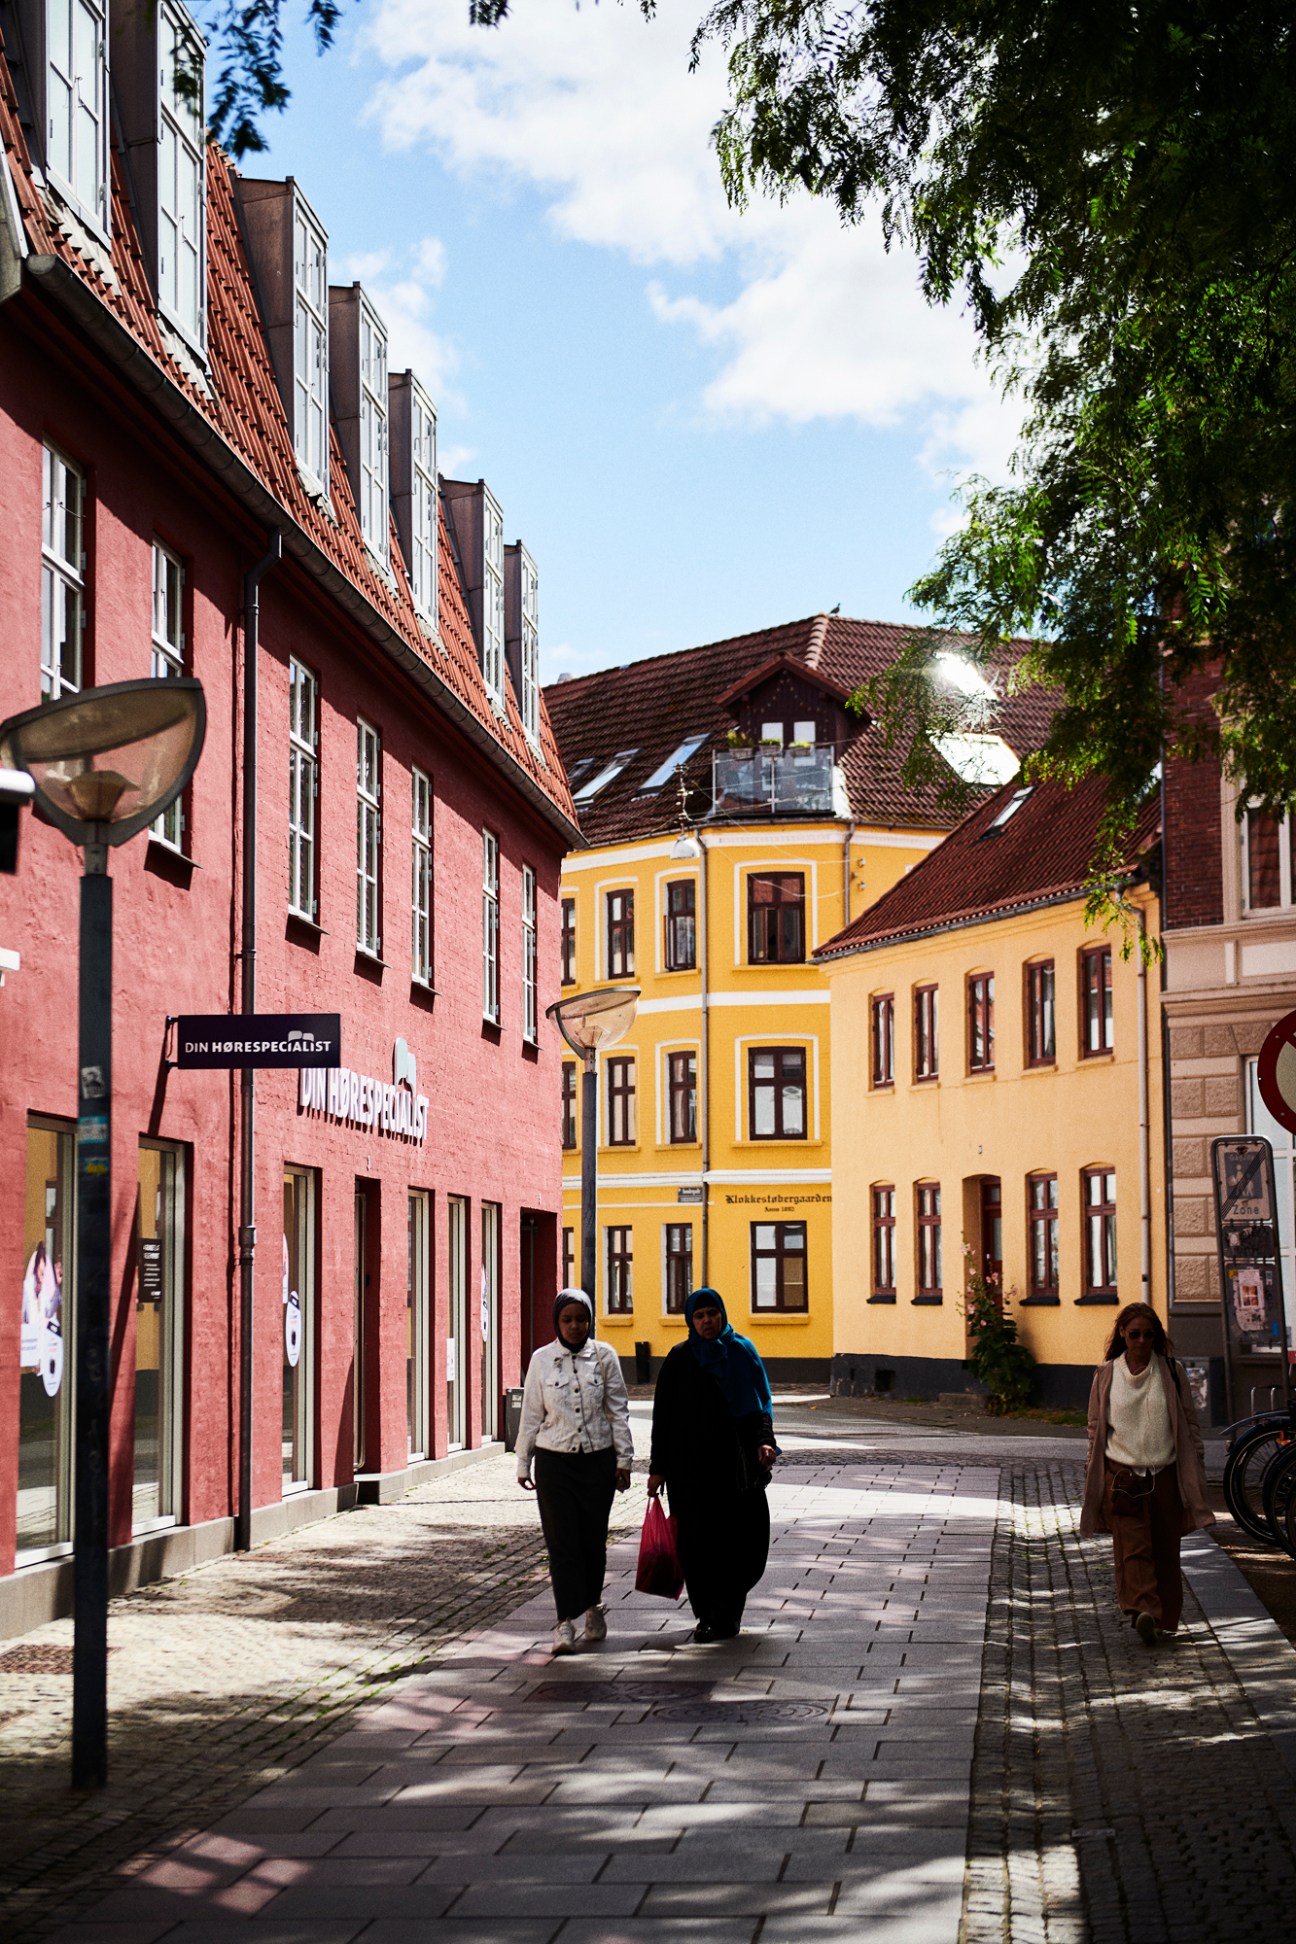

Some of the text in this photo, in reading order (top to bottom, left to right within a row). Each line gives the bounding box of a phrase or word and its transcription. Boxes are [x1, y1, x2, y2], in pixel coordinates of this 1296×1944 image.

[185, 1040, 332, 1053] DIN HØRESPECIALIST
[301, 1068, 430, 1139] DIN HØRESPECIALIST
[1233, 1204, 1260, 1215] Zone
